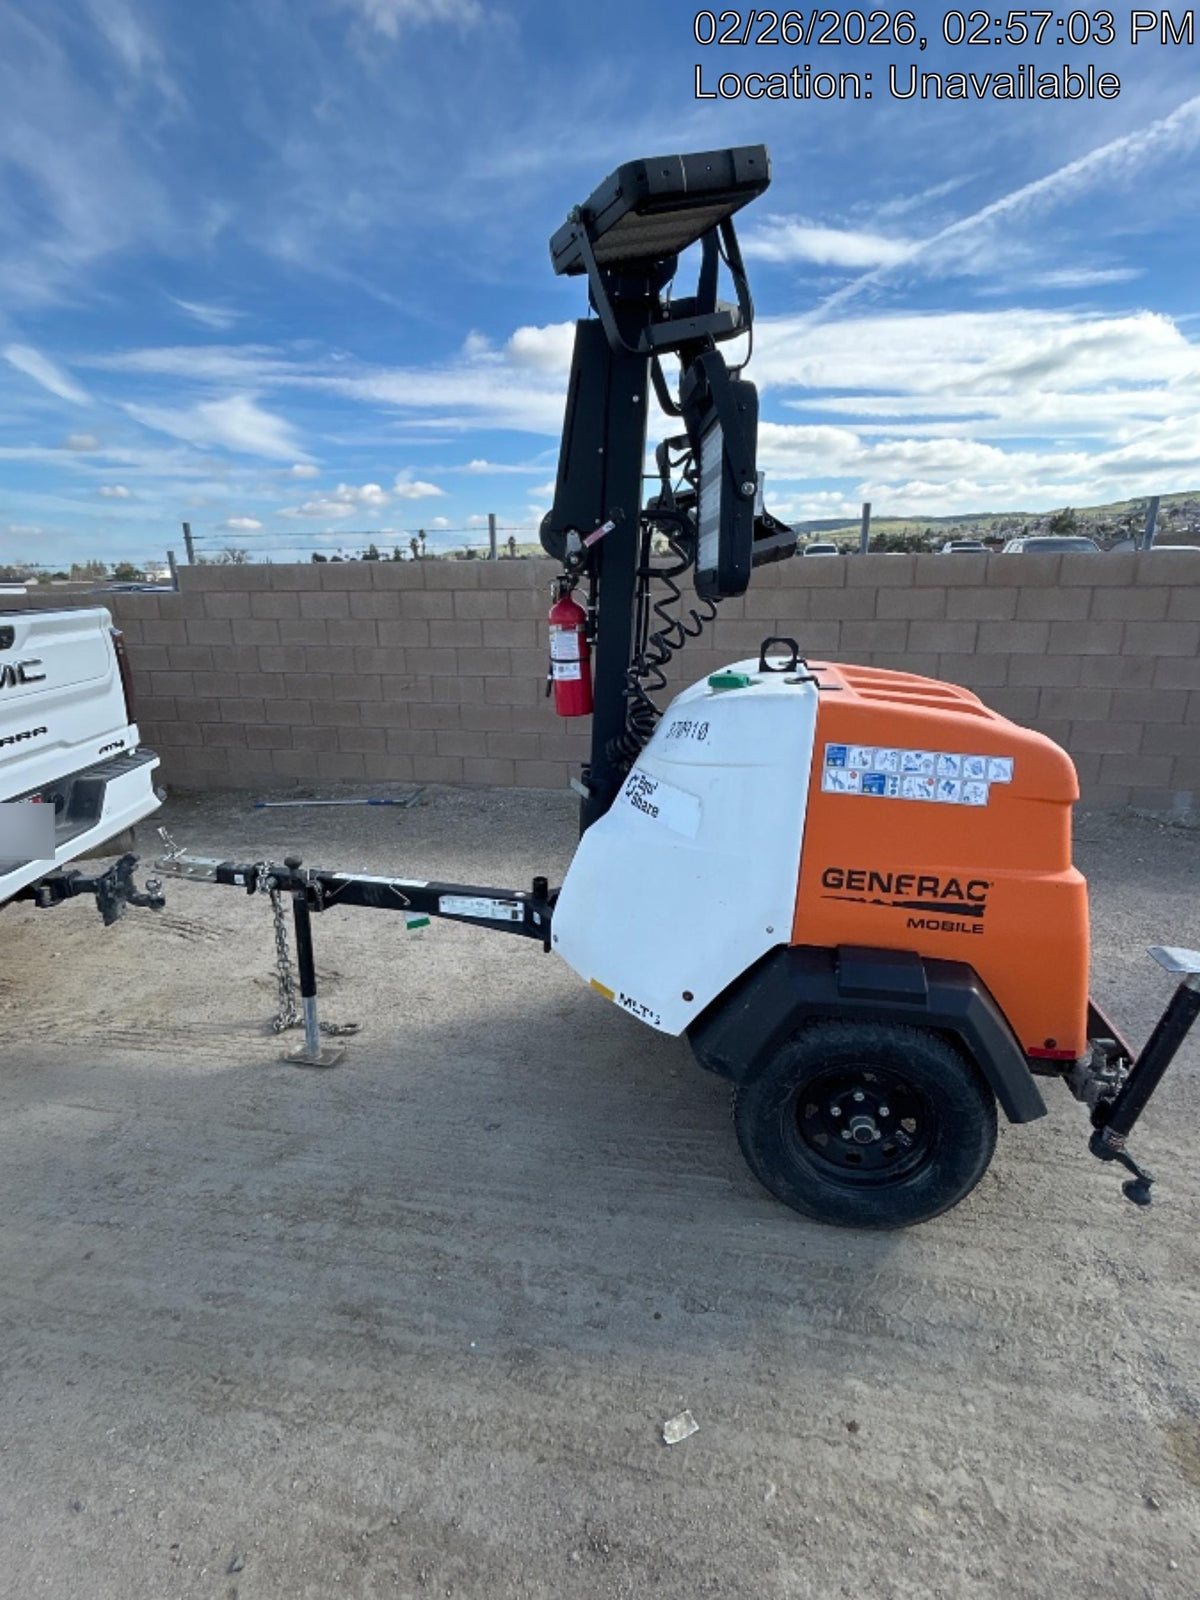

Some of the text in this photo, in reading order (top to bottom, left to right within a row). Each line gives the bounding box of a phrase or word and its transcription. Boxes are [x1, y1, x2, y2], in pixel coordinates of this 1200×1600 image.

[0, 658, 46, 689] MC
[0, 725, 47, 747] RRA
[906, 918, 985, 934] MOBILE
